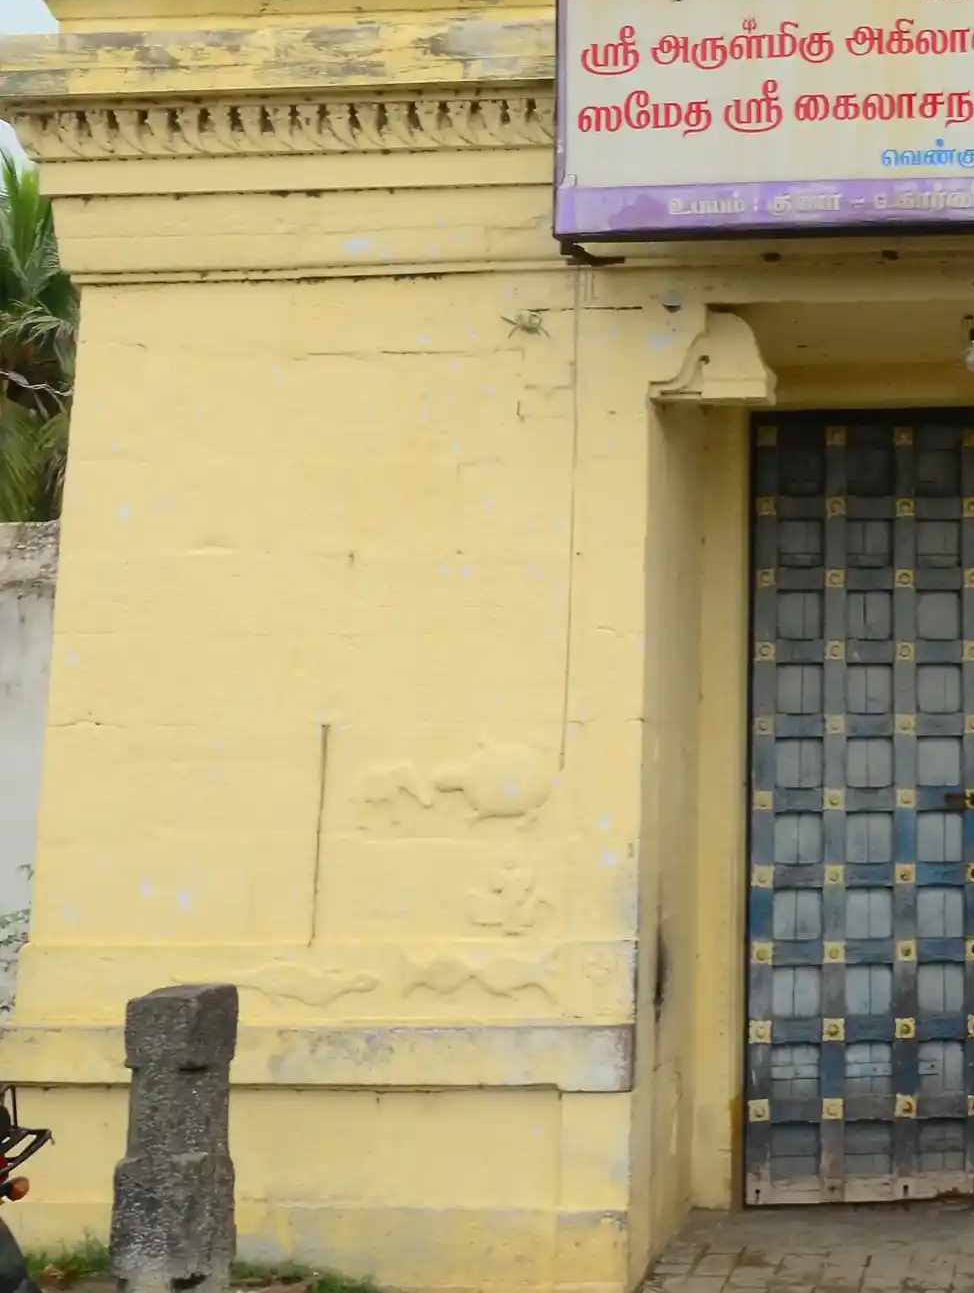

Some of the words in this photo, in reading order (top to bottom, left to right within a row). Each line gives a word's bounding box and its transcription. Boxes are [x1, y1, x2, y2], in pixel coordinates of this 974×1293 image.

[581, 25, 640, 76] ஸ்ரீ
[650, 17, 834, 70] அருள்மிகு
[577, 89, 712, 137] ஸமேத
[723, 79, 783, 134] ஸ்ரீ
